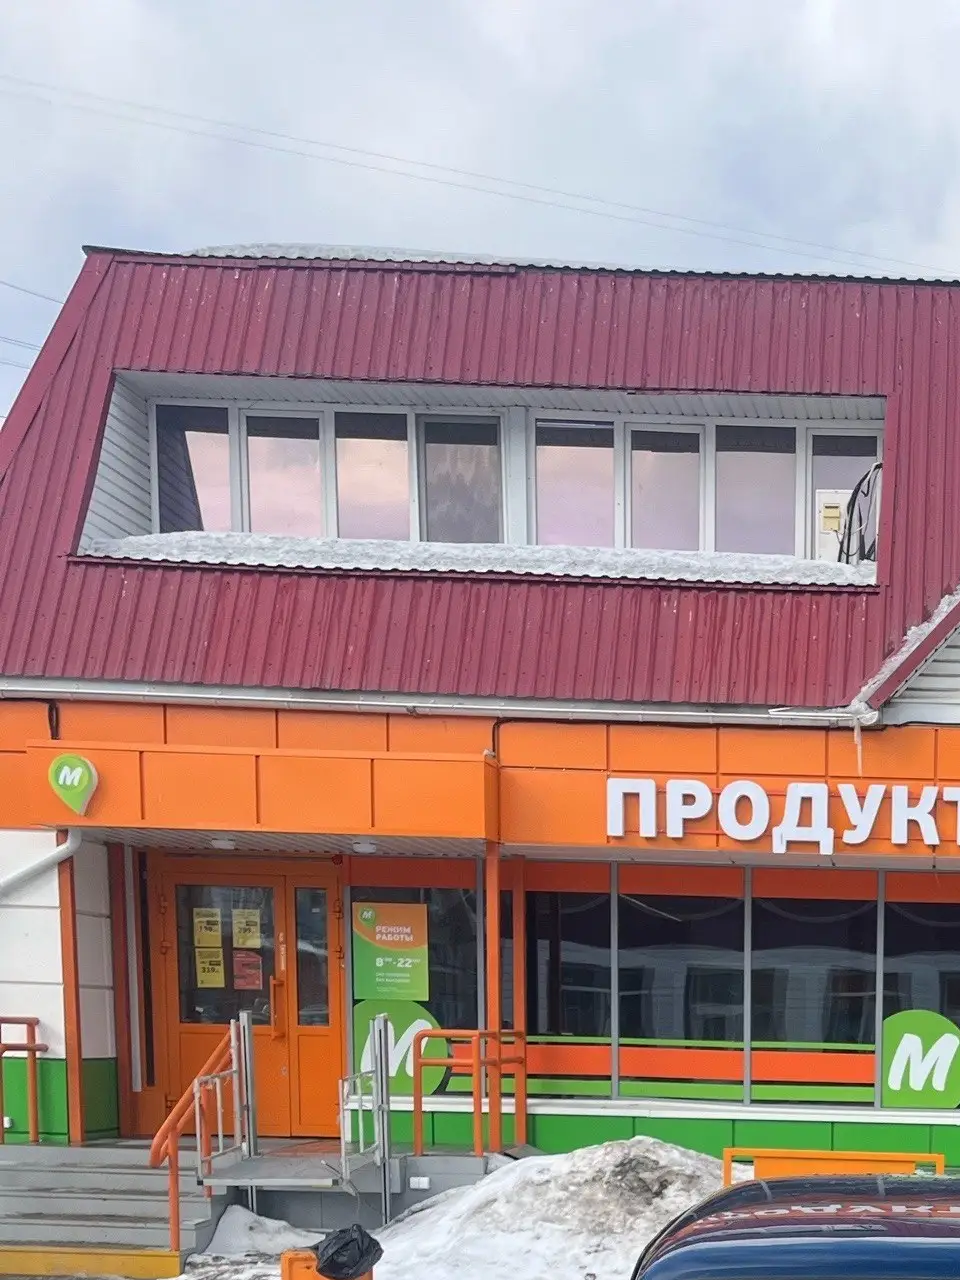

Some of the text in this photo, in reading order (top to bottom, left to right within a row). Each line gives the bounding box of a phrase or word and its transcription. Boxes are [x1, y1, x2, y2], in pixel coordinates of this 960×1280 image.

[375, 925, 412, 934] РЕЖИМ
[375, 934, 414, 942] РАБОТЫ
[887, 1033, 960, 1092] М
